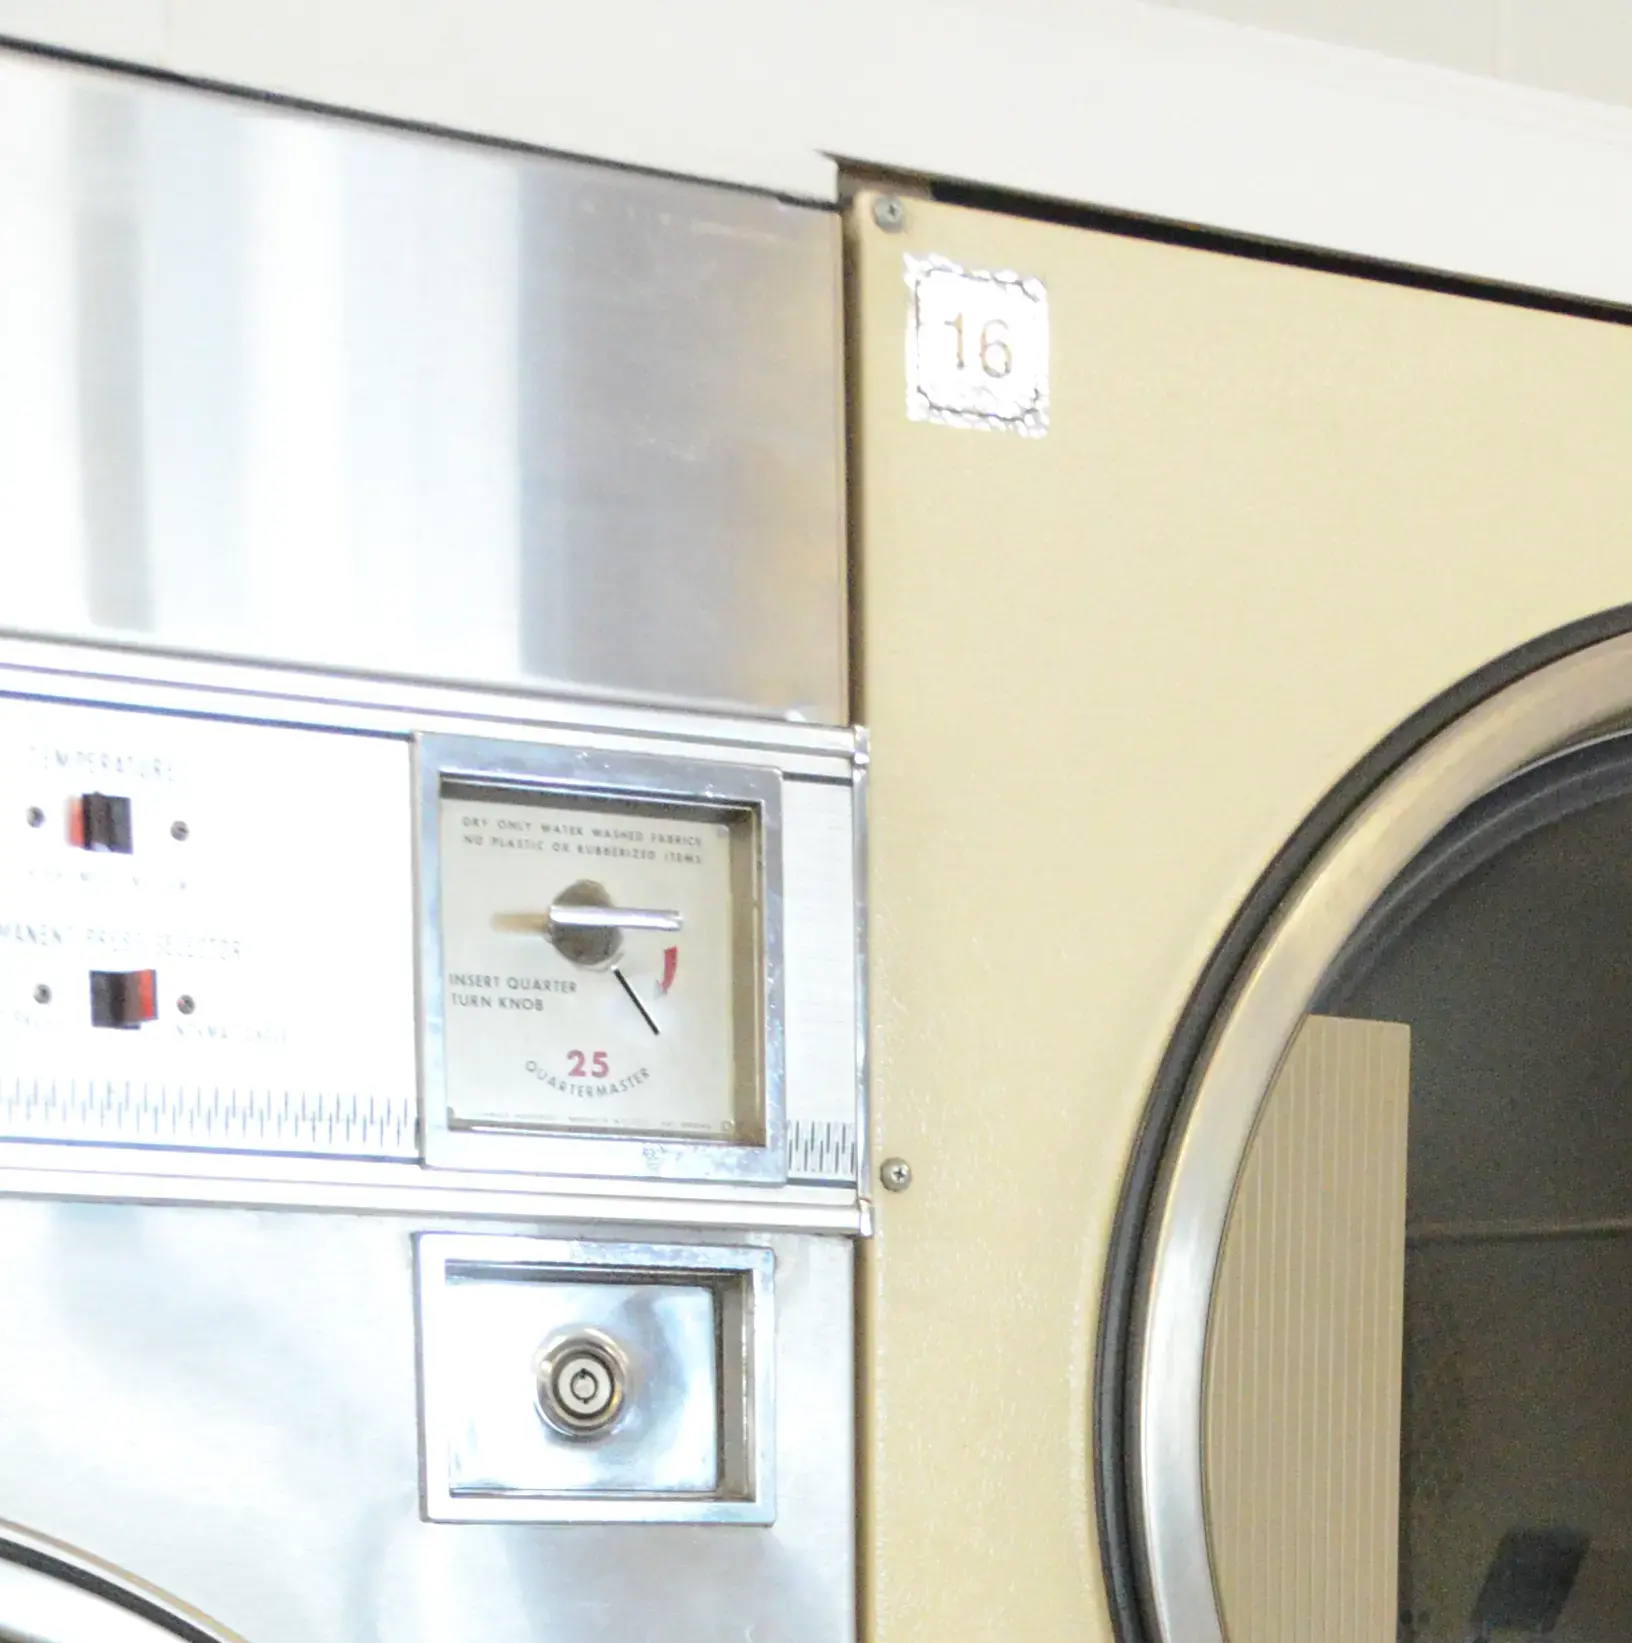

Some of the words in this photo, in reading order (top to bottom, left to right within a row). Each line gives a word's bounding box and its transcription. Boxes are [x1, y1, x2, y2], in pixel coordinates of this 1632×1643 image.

[944, 312, 1012, 379] 16
[462, 816, 489, 830] DRY
[497, 819, 533, 833] ONLY
[540, 823, 584, 837] WATER
[592, 827, 643, 842] WASHED
[651, 832, 702, 848] FABRICS
[462, 834, 484, 846] NO
[491, 837, 544, 852] PLASTIC
[552, 841, 570, 853] OR
[577, 844, 655, 861] RUBBERIZED
[664, 850, 703, 865] ITEMS
[449, 973, 500, 989] INSERT
[508, 977, 577, 994] QUARTER
[451, 994, 493, 1008] TURN
[498, 996, 545, 1012] KNOB
[525, 1060, 651, 1098] QUARTERMASTER
[566, 1049, 610, 1079] 25
